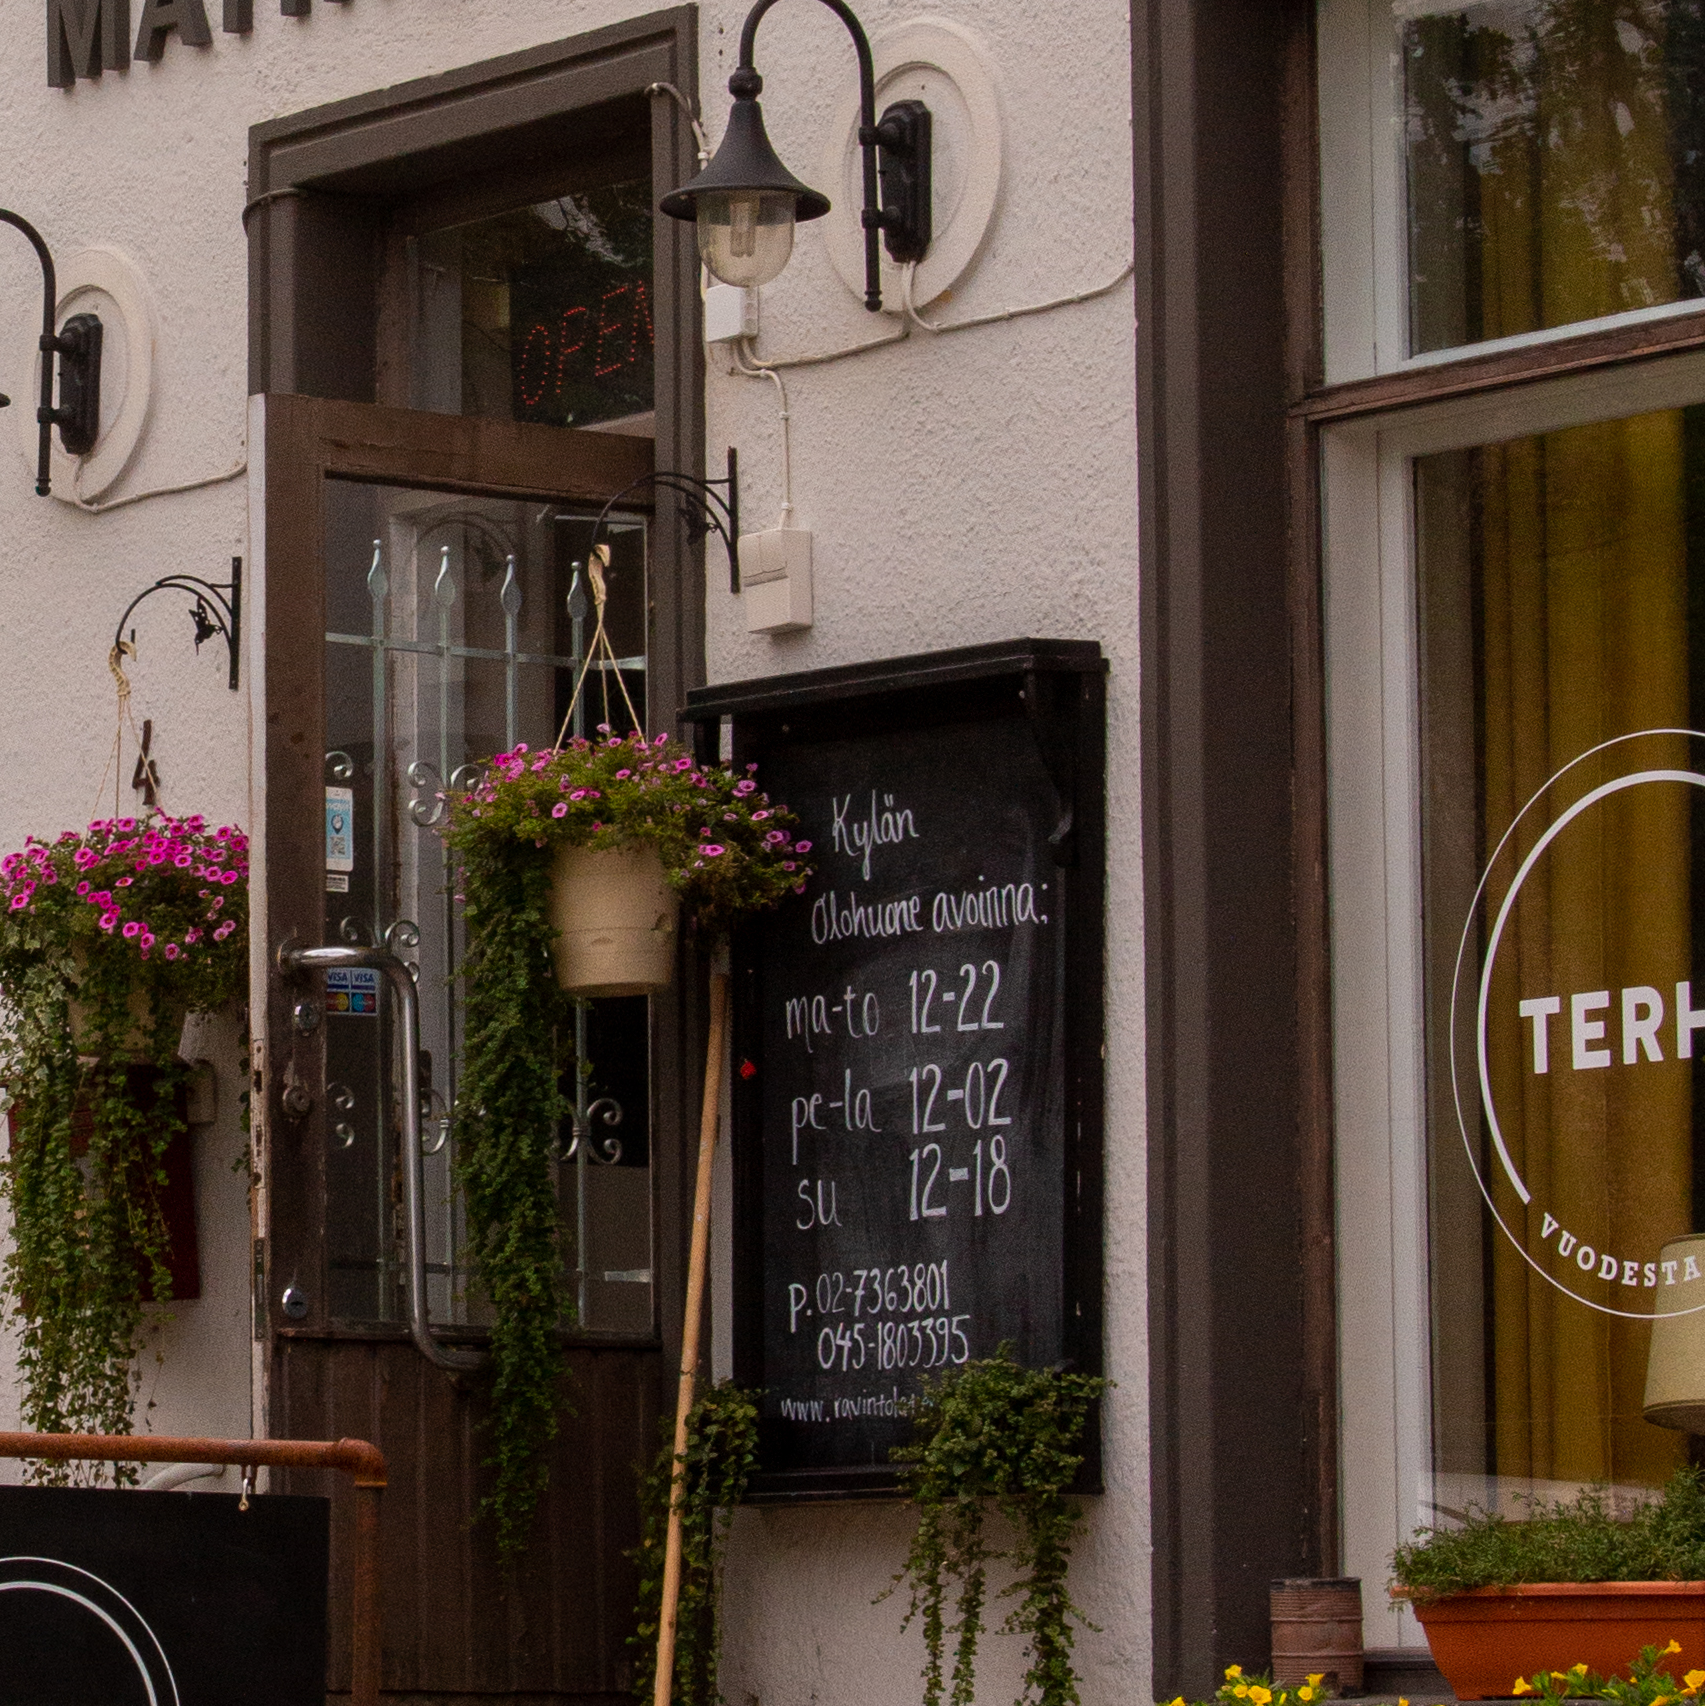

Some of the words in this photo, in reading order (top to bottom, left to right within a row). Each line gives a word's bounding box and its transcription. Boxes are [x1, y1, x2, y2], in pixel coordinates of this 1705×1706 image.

[520, 280, 654, 405] OPEN
[131, 719, 161, 807] 4
[831, 789, 920, 881] Kylän
[328, 972, 348, 982] VISA
[354, 973, 375, 984] VISA
[785, 985, 880, 1053] ma-to
[909, 960, 1004, 1034] 12-22
[791, 1068, 882, 1165] pe-la
[909, 1058, 1012, 1134] 12-02
[796, 1179, 842, 1230] su
[909, 1134, 1011, 1221] 12-18
[1541, 1212, 1702, 1287] VUODESTA
[817, 1314, 971, 1372] 045-1803395
